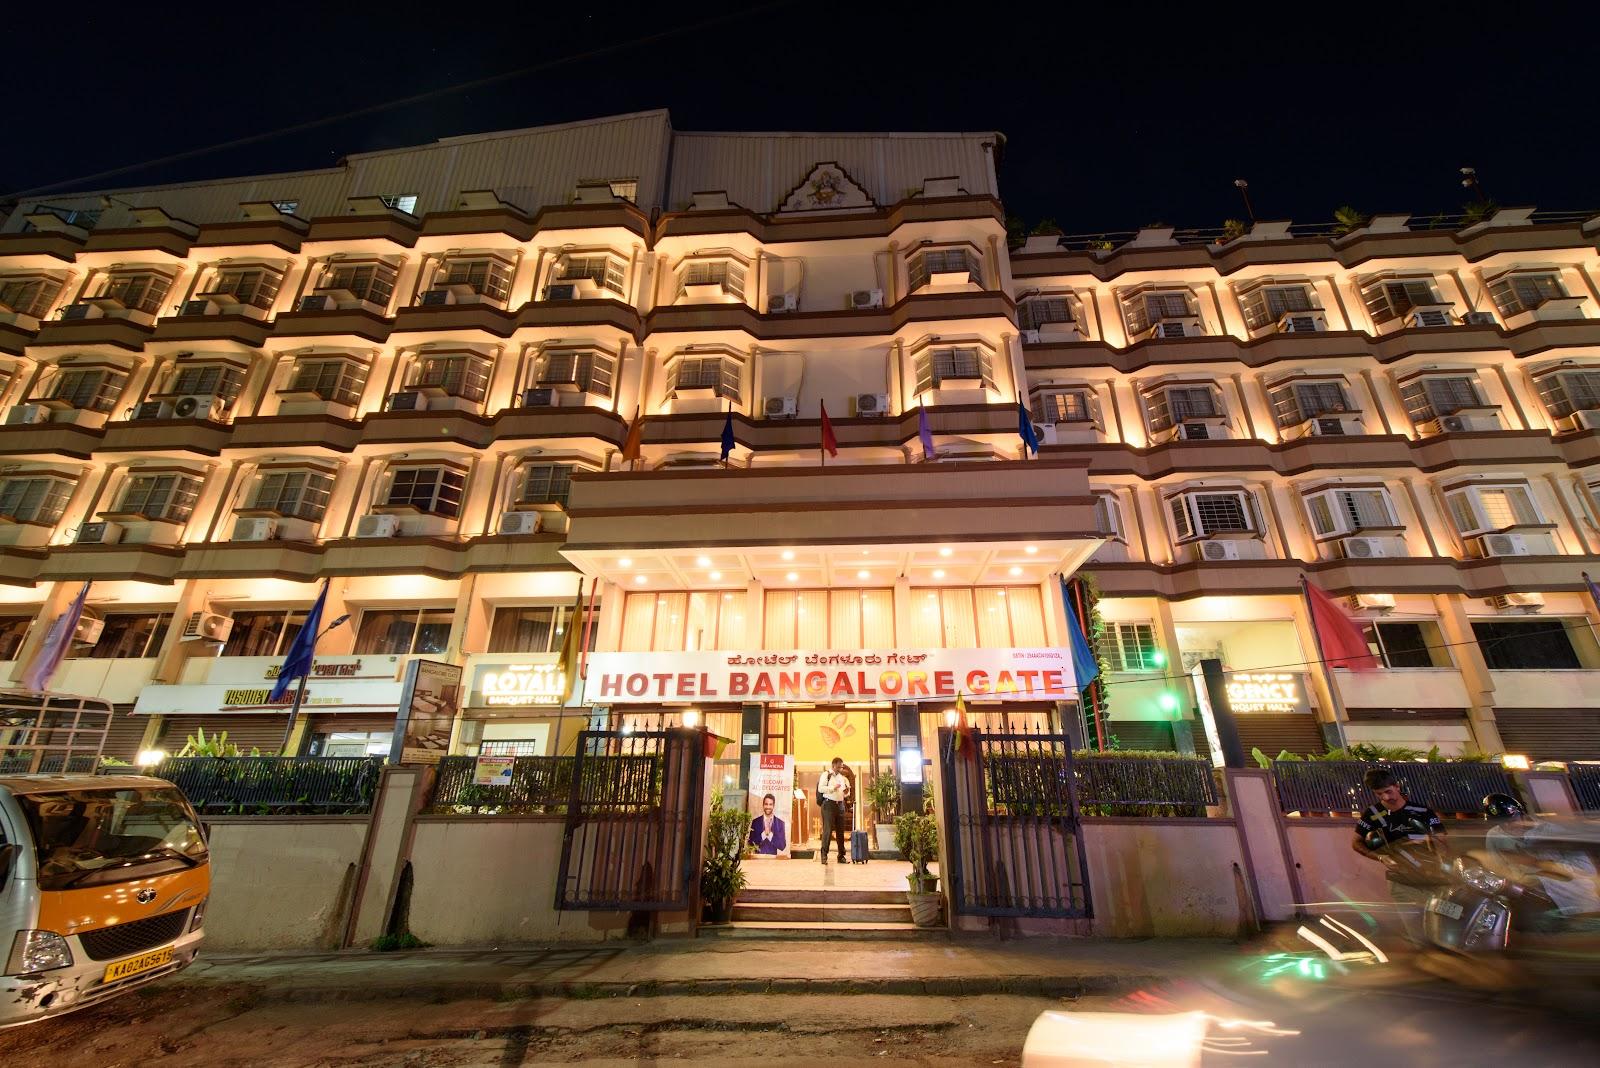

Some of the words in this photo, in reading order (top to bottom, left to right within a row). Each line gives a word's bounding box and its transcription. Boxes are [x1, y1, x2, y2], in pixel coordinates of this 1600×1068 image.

[727, 654, 799, 666] ಹೋಟೆಲ್
[887, 652, 929, 665] ಗೇಟ್
[600, 672, 717, 697] HOTEL
[728, 670, 955, 697] BANGALORE
[965, 669, 1065, 695] GATE
[224, 689, 270, 705] VASUDEV
[536, 695, 560, 704] HALL
